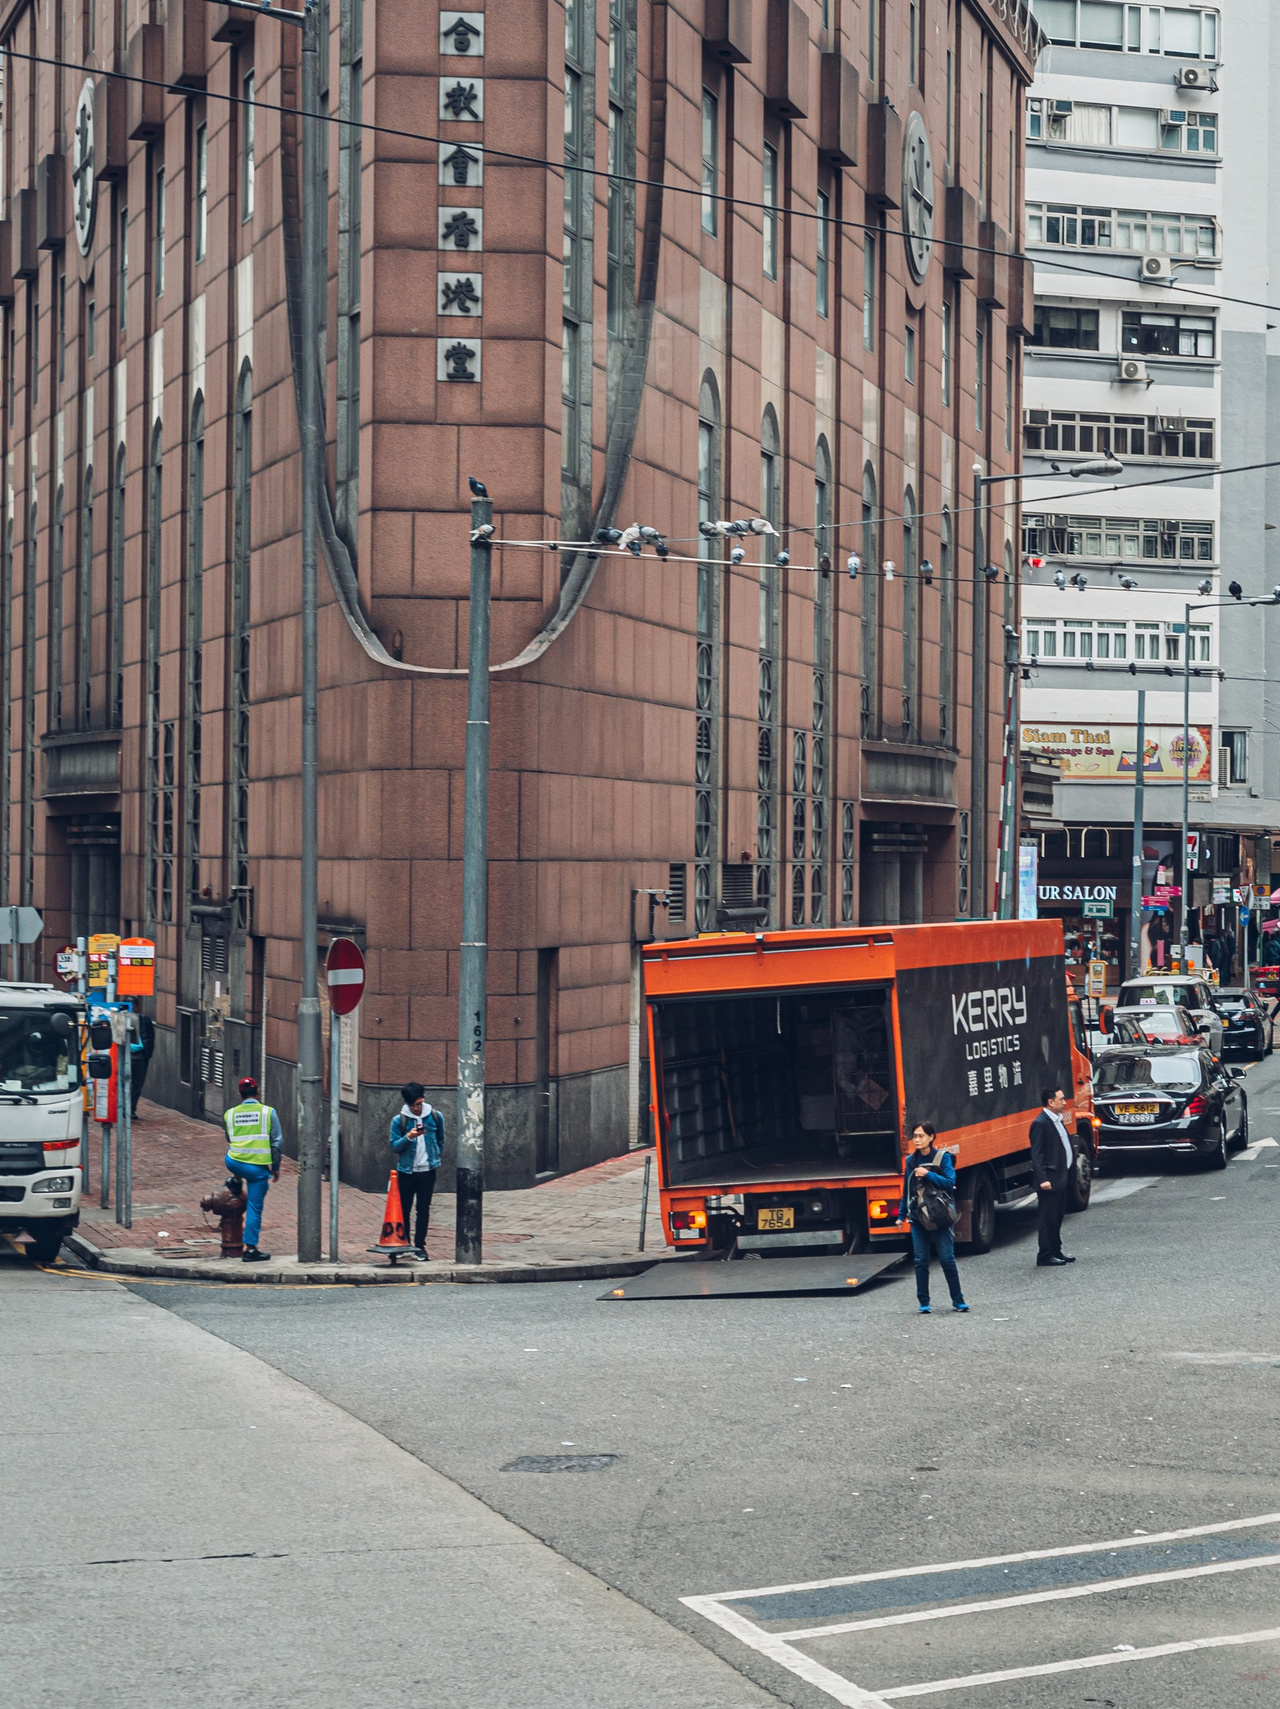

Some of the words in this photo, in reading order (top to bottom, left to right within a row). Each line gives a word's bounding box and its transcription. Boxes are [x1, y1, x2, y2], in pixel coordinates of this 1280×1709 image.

[1022, 728, 1066, 744] Siam
[1070, 729, 1111, 744] Thai
[1041, 746, 1083, 757] Massage
[1084, 747, 1094, 756] &
[1096, 747, 1115, 757] Spa
[1063, 885, 1117, 900] SALON
[952, 985, 1028, 1035] KERRY
[966, 1035, 1020, 1061] LOGISTICS
[967, 1060, 1023, 1097] 嘉里物流
[1118, 1105, 1131, 1113] VE
[1134, 1104, 1156, 1113] 5612
[768, 1209, 784, 1220] TG
[761, 1218, 791, 1229] 7654
